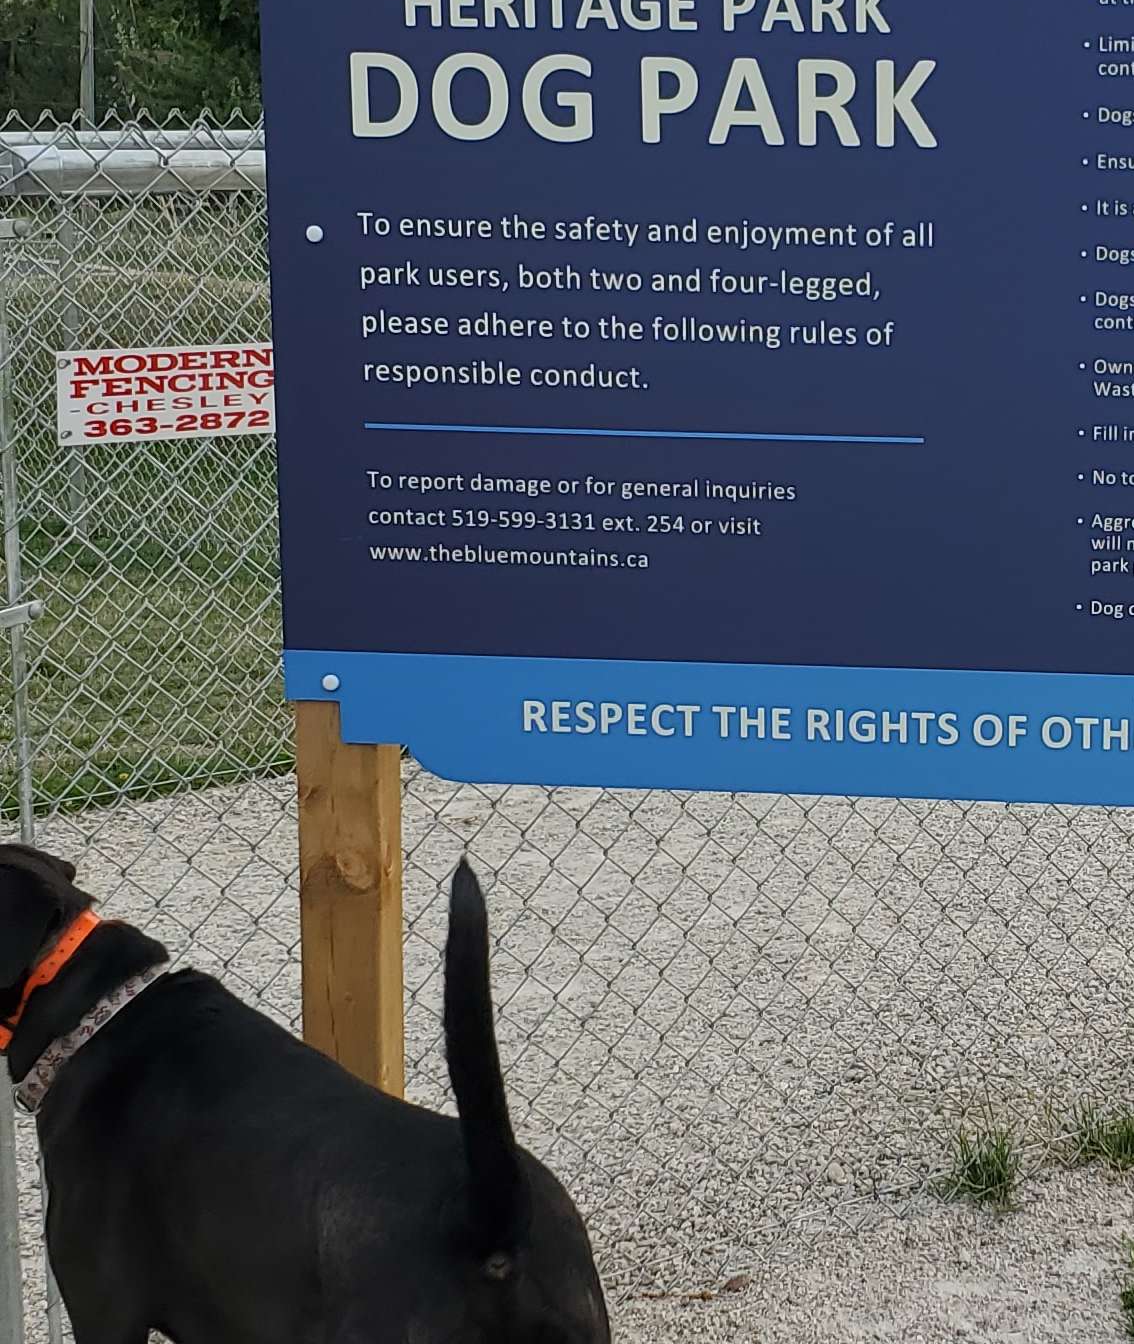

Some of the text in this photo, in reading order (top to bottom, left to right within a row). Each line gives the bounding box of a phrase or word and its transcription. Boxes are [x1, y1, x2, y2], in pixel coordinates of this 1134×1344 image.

[350, 52, 937, 147] DOG PARK
[357, 212, 932, 250] To ensure the safety and enjoyment of all
[361, 261, 879, 300] park users, both two and four-legged,
[363, 310, 894, 348] please adhere to the following rules of
[73, 349, 273, 376] MODERN
[364, 361, 647, 388] responsible conduct.
[70, 370, 274, 399] FENCING
[84, 410, 269, 438] 363-2872
[367, 471, 795, 502] To report damage or for general inquiries
[1093, 470, 1116, 484] No
[369, 510, 760, 535] contact 519-599-3131 ext. 254 or visit
[370, 544, 648, 567] www.thebluemountains.ca
[1092, 558, 1128, 574] park
[1092, 601, 1123, 618] Dog
[524, 701, 700, 736] RESPECT
[713, 707, 790, 739] THE
[808, 710, 958, 744] RIGHTS
[974, 715, 1027, 746] OF
